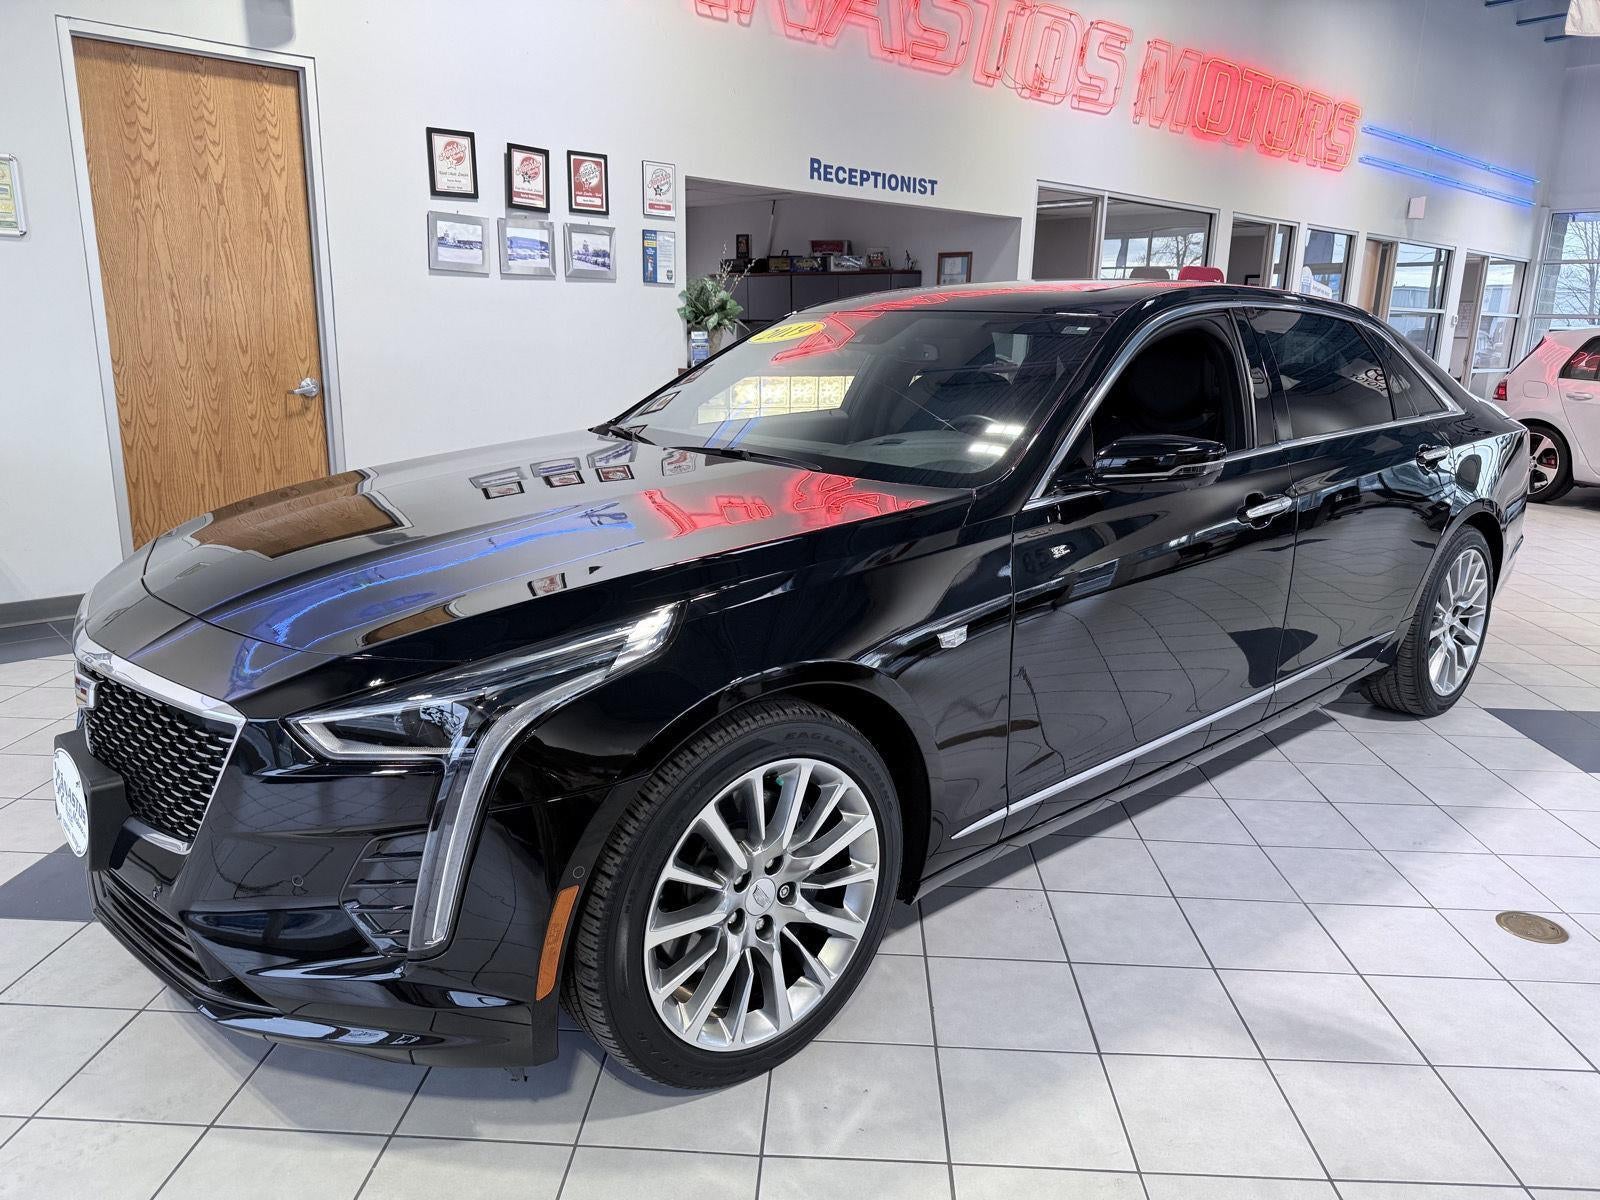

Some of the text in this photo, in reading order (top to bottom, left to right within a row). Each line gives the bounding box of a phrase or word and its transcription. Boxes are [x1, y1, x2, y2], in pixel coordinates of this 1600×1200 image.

[693, 0, 1362, 170] ASTOS MOTORS
[810, 157, 937, 196] RECEPTIONIST
[755, 323, 817, 341] 2019
